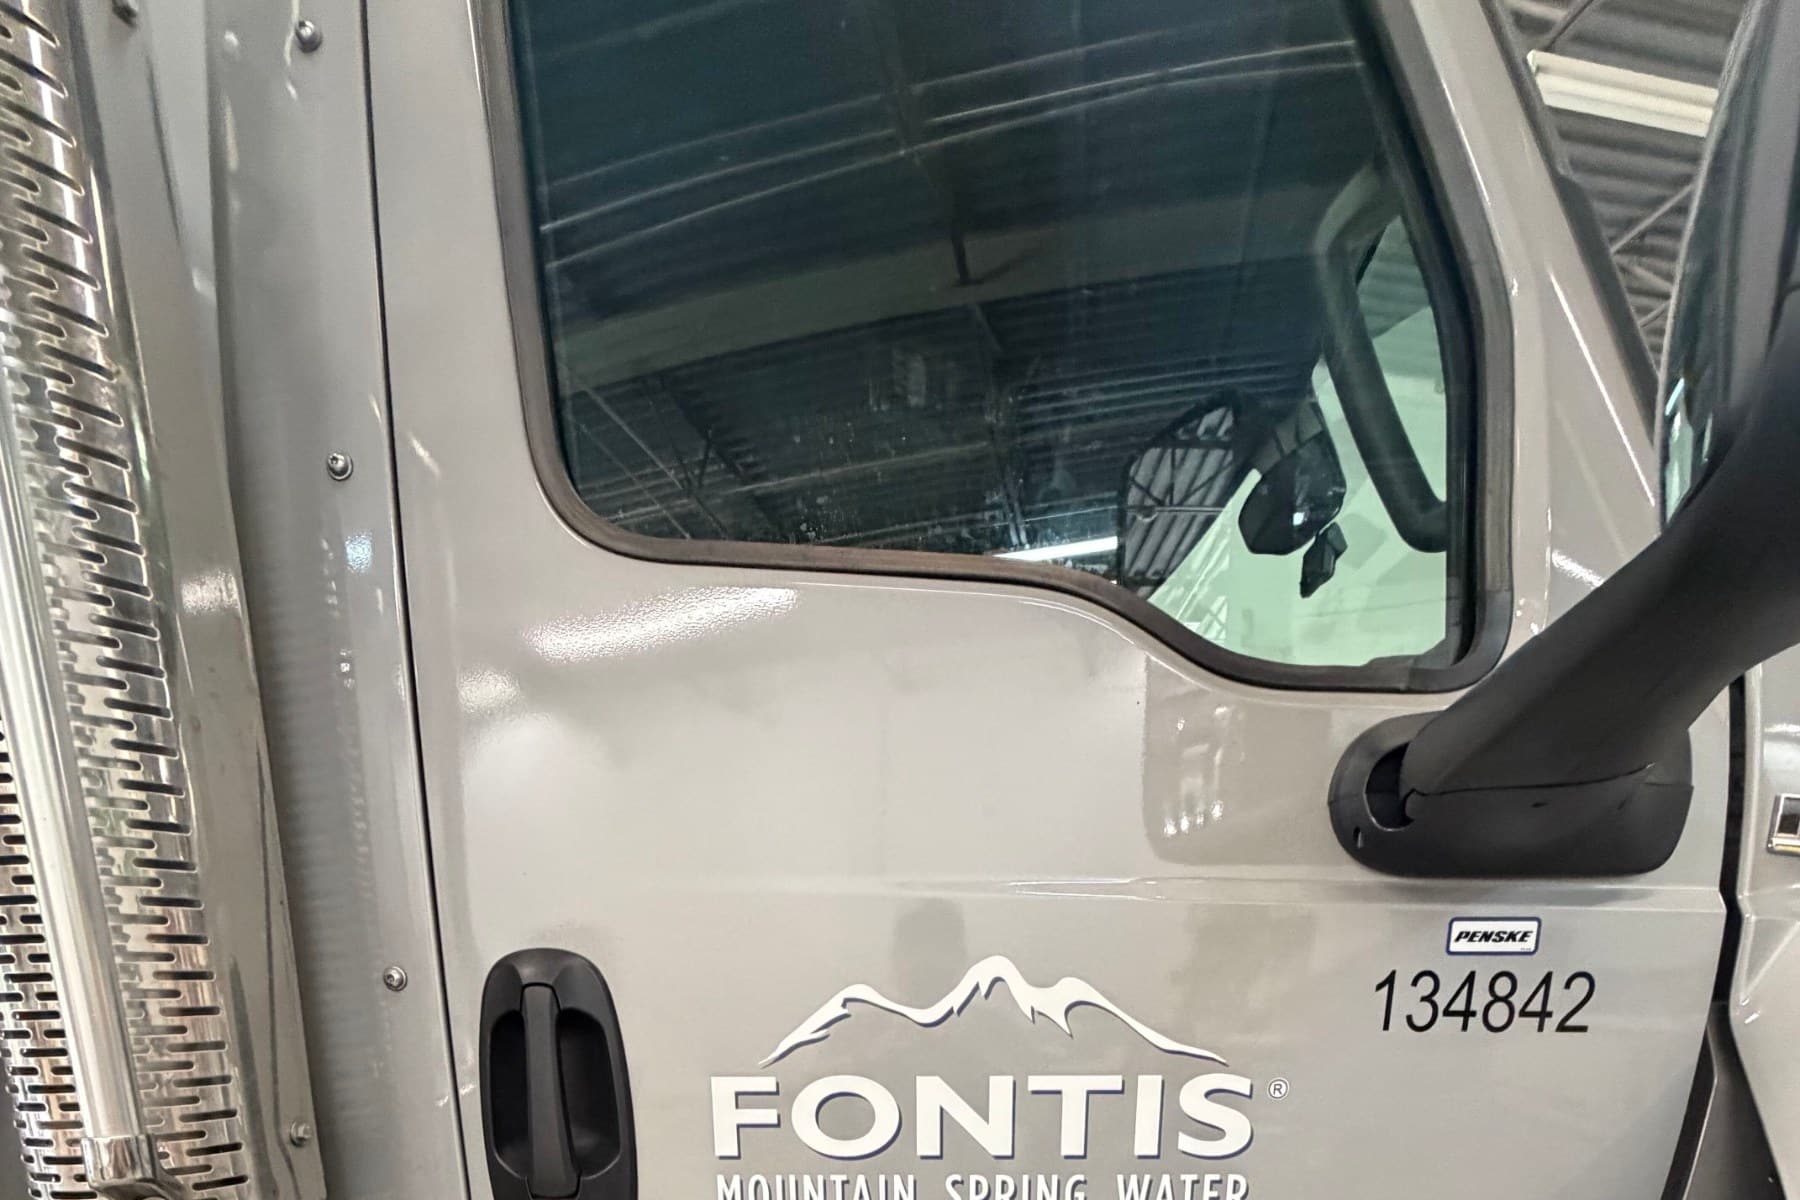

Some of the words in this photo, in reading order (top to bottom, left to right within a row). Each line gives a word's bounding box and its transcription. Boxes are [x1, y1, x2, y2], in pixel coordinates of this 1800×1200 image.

[1454, 930, 1534, 943] PENSKE
[1375, 969, 1596, 1033] 134842
[710, 1073, 1254, 1160] FONTIS
